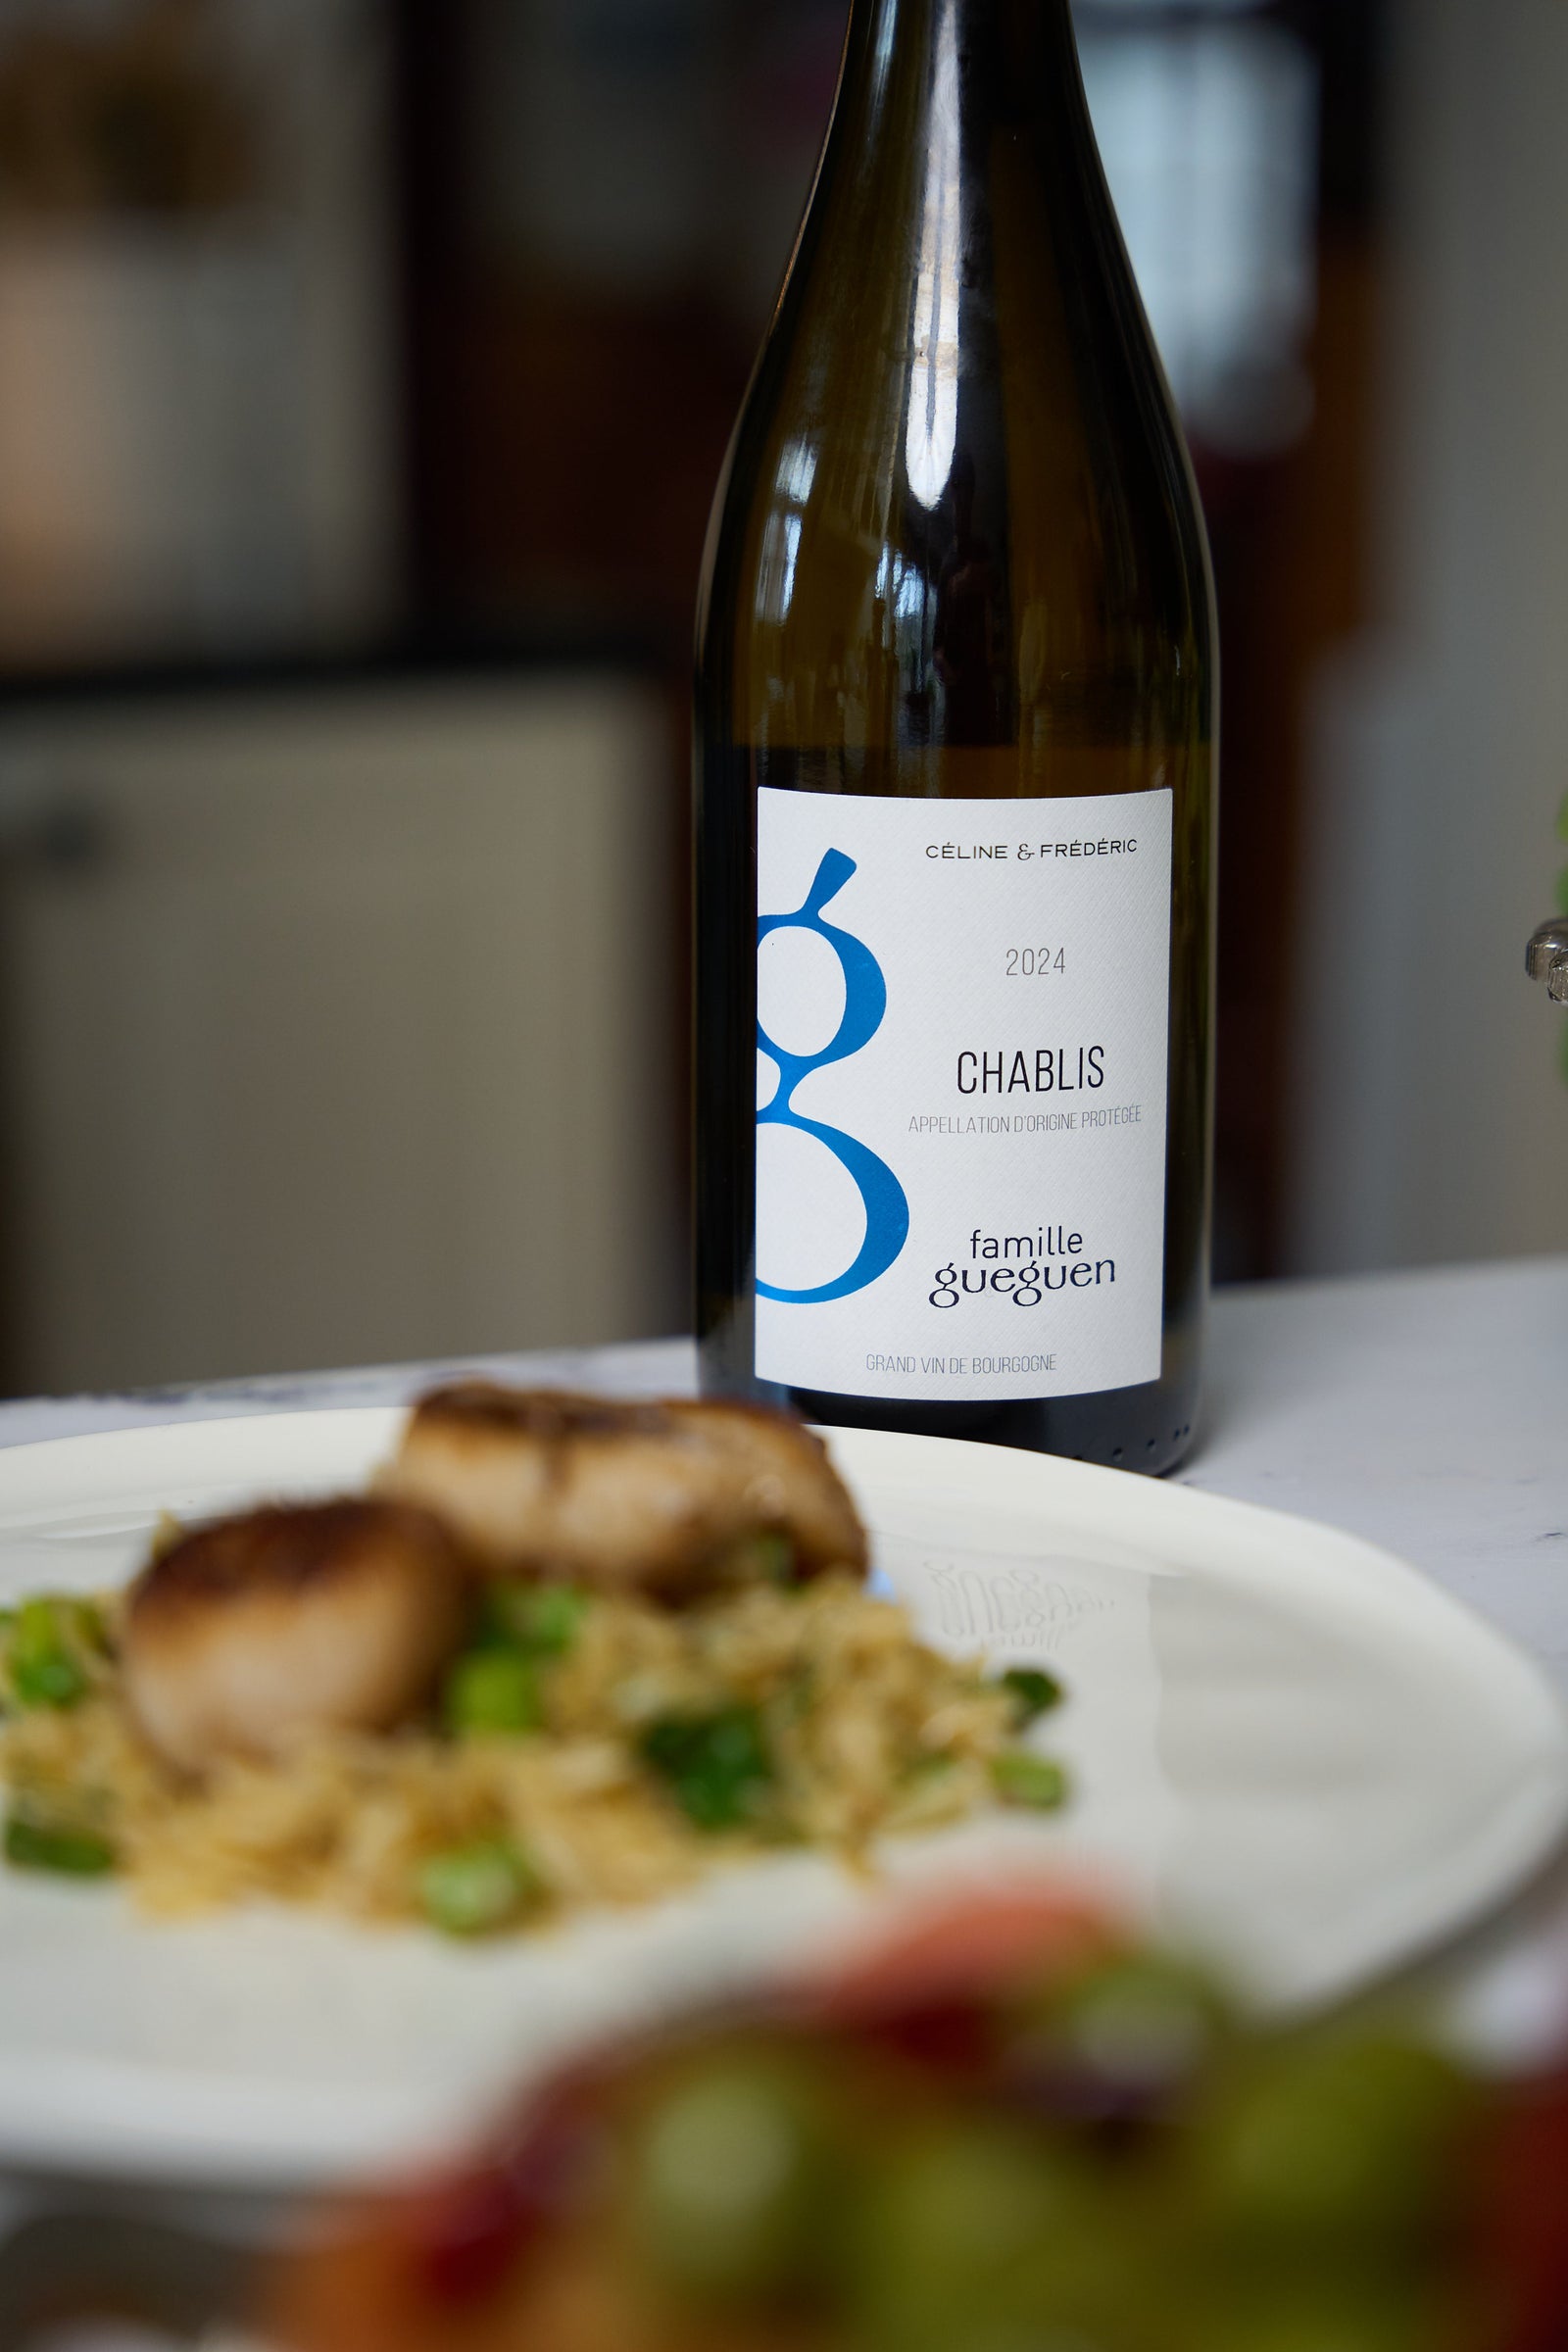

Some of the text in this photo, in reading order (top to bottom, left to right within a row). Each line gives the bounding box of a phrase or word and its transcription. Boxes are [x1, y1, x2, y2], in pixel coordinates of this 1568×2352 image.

[925, 837, 1138, 860] CÉLINE & FRÉDÉRIC
[1005, 947, 1066, 976] 2024
[956, 1045, 1104, 1094] CHABLIS
[907, 1103, 1142, 1134] APPELLATION D'ORIGINE PROTÉGÉE
[969, 1225, 1084, 1259] famille
[928, 1258, 1116, 1308] gueguen
[865, 1353, 1057, 1375] GRAND VIN DE BOURGOGNE
